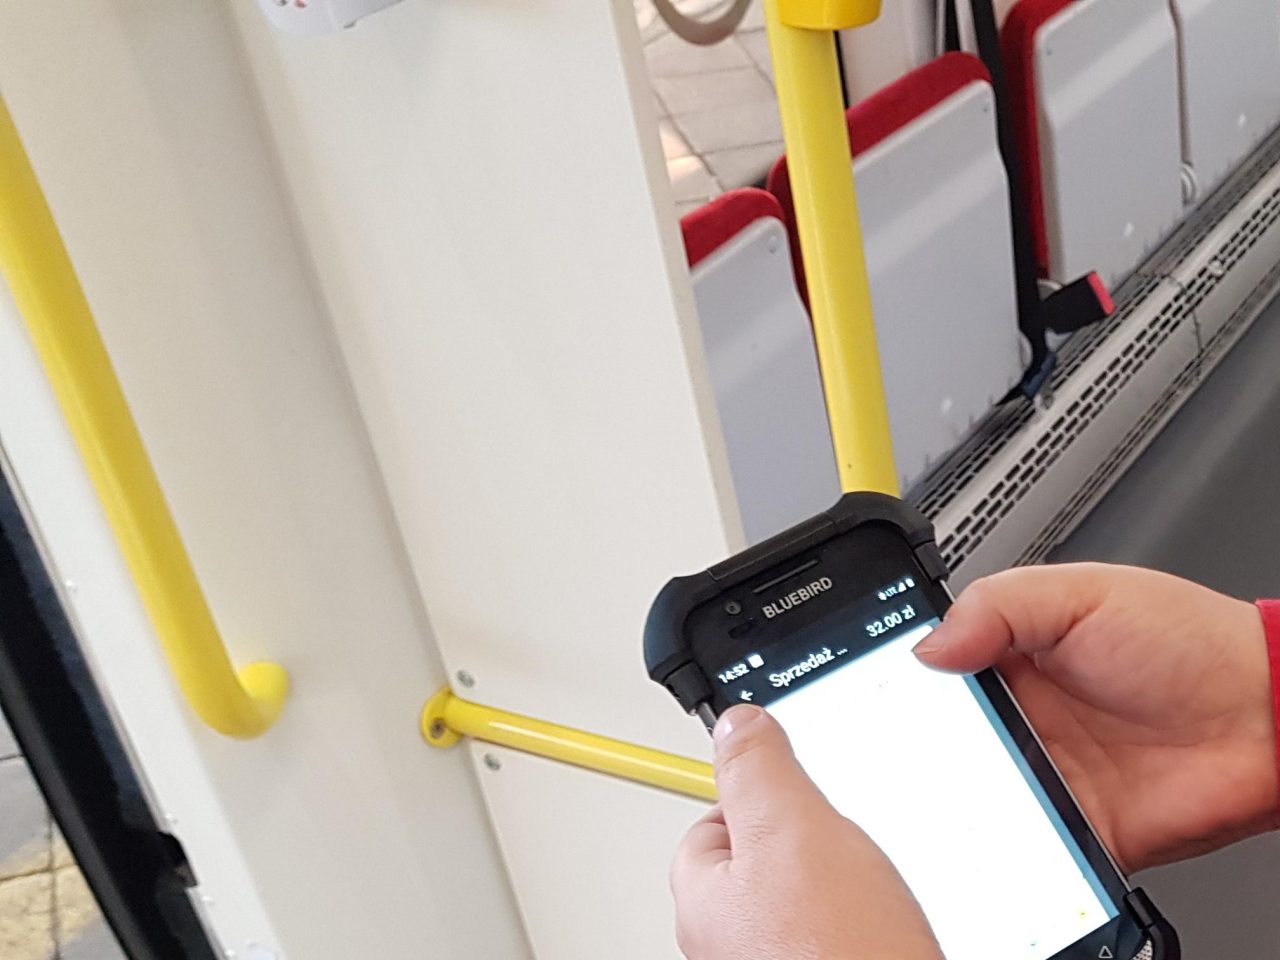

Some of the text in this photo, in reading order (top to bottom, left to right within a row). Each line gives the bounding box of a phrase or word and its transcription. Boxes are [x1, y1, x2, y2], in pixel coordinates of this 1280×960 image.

[762, 577, 833, 619] BLUEBIRD
[769, 647, 835, 687] Sprzedaż
[866, 612, 902, 637] 32.00
[901, 604, 916, 620] zł
[718, 663, 750, 684] 14:52
